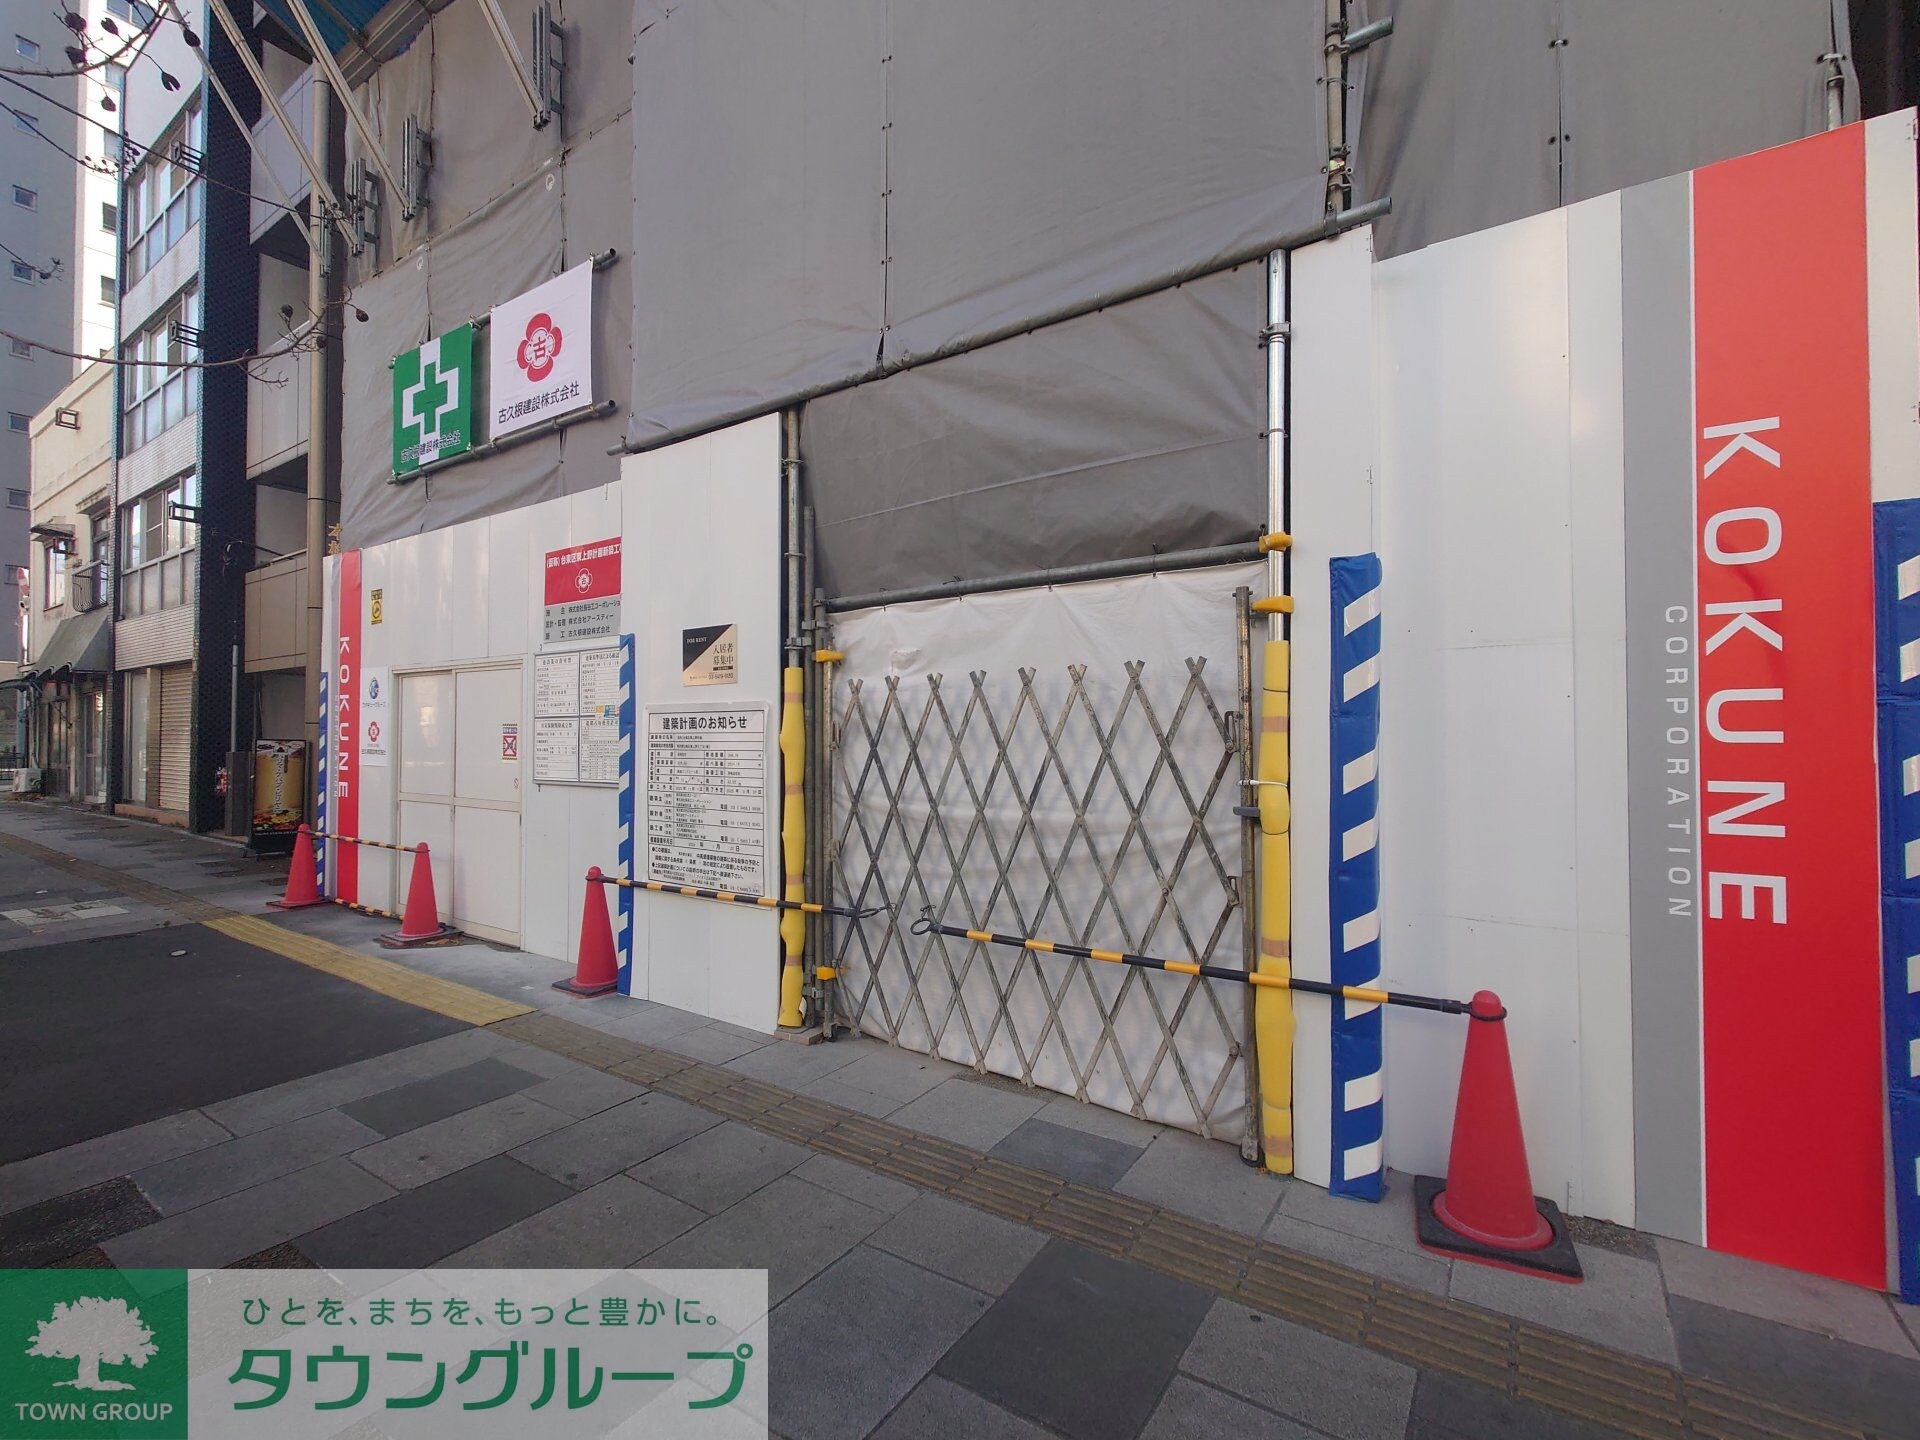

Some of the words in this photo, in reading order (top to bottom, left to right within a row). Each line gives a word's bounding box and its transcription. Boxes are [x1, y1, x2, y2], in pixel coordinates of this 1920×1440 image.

[533, 337, 547, 361] 古
[498, 382, 580, 424] 古久根建設株式会社
[400, 430, 461, 464] 古久根建設株式会社
[569, 626, 610, 638] 古久根建設株式会社
[713, 643, 733, 654] 入居者
[713, 655, 733, 665] 募集中
[1702, 415, 1788, 925] KOKUNE
[338, 636, 350, 798] KOKUNE
[662, 716, 747, 730] 建築計画のお知らせ
[1664, 604, 1692, 918] CORPORATION
